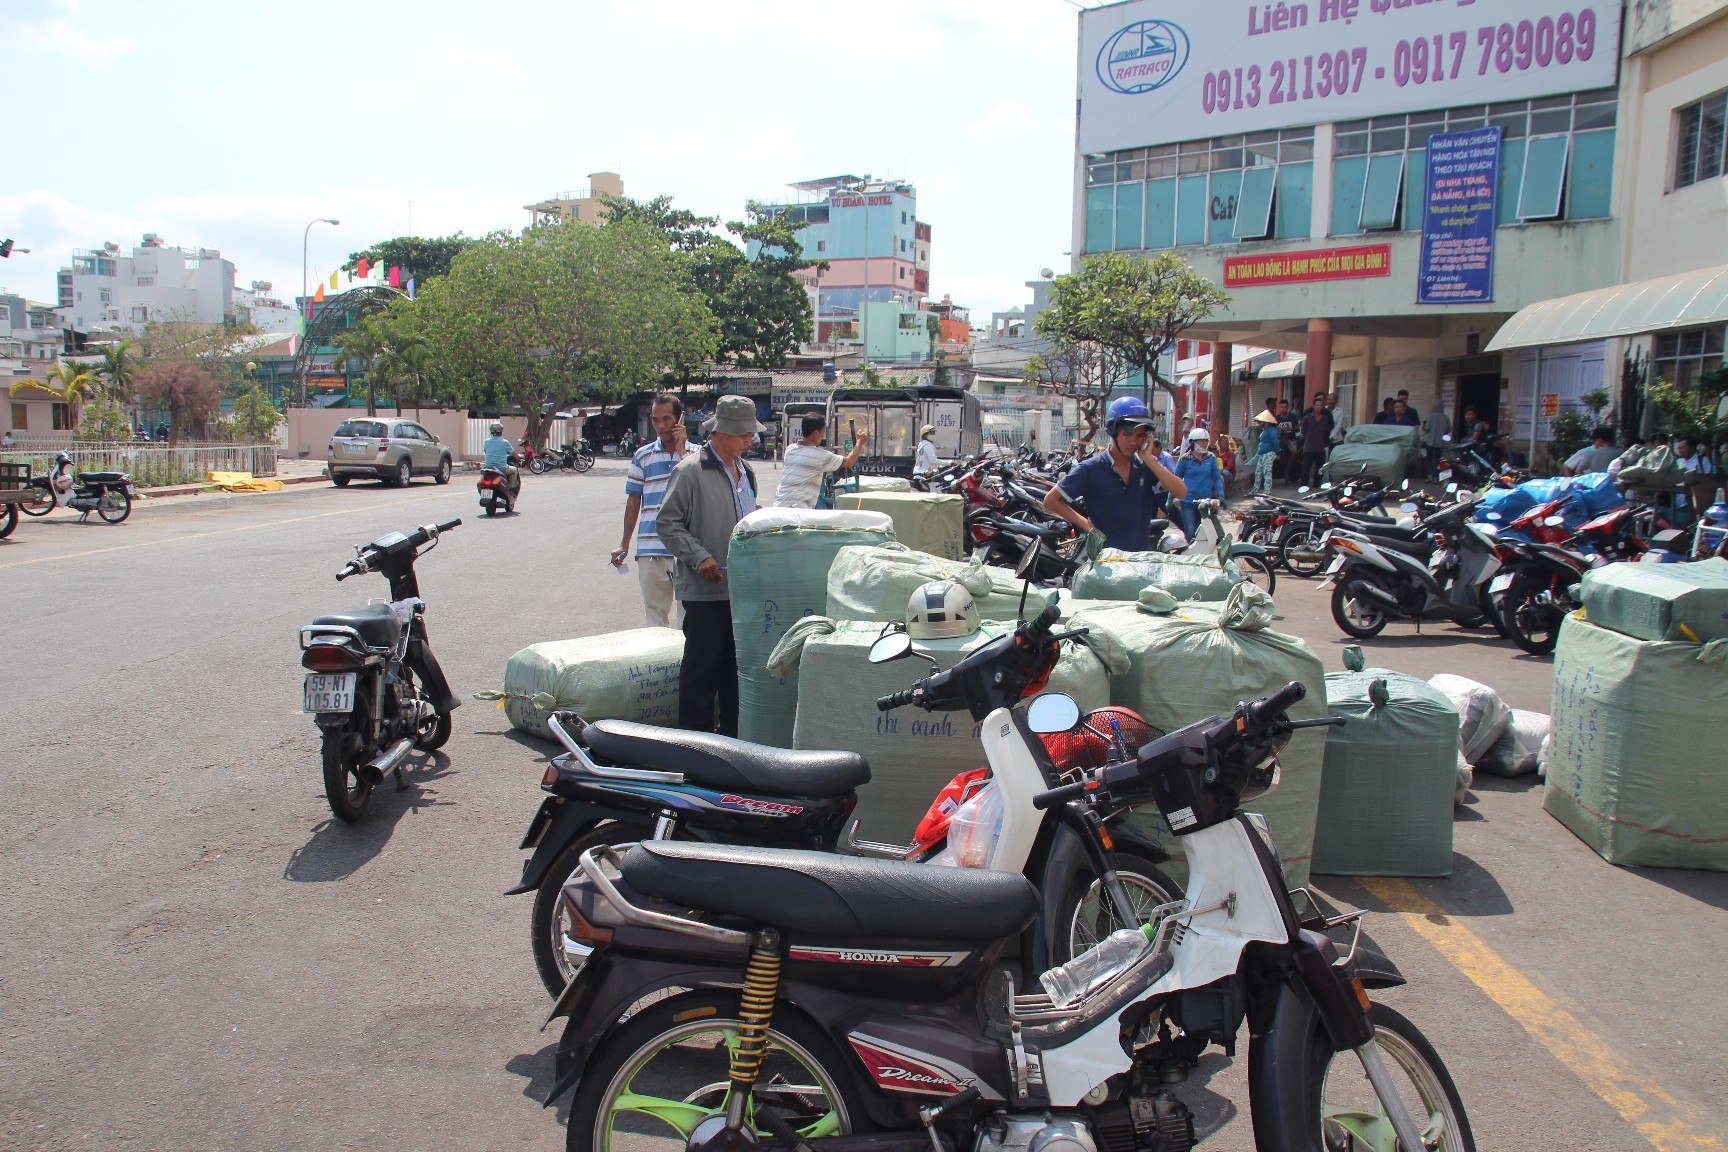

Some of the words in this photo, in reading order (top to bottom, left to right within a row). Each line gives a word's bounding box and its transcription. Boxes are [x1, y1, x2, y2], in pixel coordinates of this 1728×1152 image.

[1247, 1, 1308, 36] Liên
[1115, 60, 1170, 80] RATRACO
[1202, 64, 1261, 114] 0913
[1268, 46, 1368, 104] 211307
[1374, 66, 1386, 79] -
[1394, 31, 1466, 87] 0917
[1477, 8, 1596, 75] 789089
[1434, 164, 1452, 175] THEO
[868, 196, 893, 206] HOTEL
[1228, 265, 1237, 280] AN
[1237, 259, 1252, 279] TOÀN
[1253, 264, 1265, 278] LAO
[1265, 257, 1282, 280] ĐỘNG
[1282, 256, 1291, 275] LÀ
[1292, 258, 1309, 278] HẠNH
[1310, 254, 1326, 273] PHÚC
[1327, 252, 1340, 271] CỦA
[1341, 255, 1353, 274] MỌI
[1354, 253, 1365, 271] GIA
[1366, 250, 1382, 269] ĐÌNH
[311, 675, 347, 692] 59-N1
[306, 692, 350, 710] 105.81
[720, 793, 804, 815] Dream
[838, 951, 900, 963] HONDA
[877, 1066, 954, 1086] Dream
